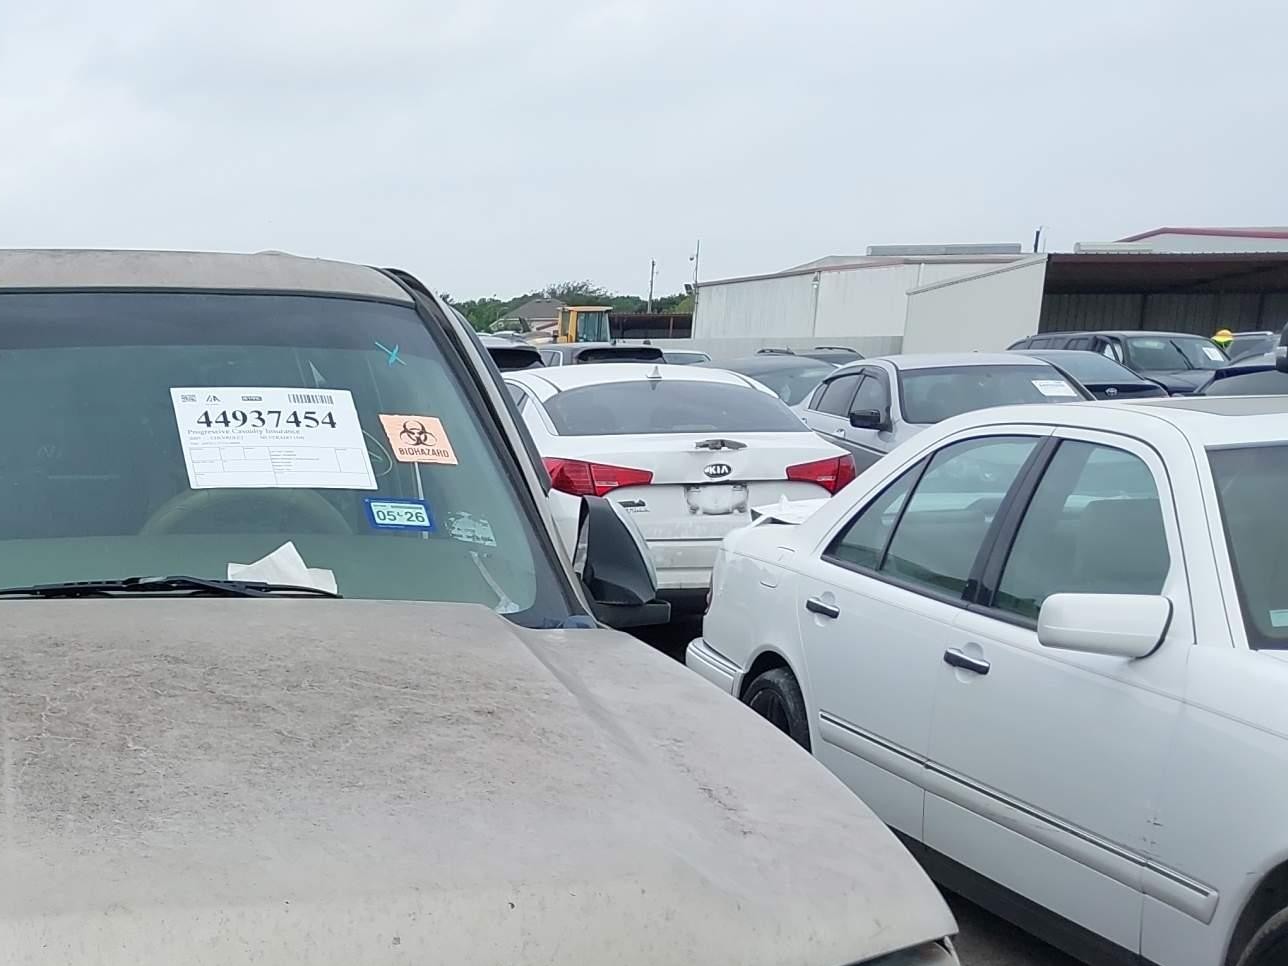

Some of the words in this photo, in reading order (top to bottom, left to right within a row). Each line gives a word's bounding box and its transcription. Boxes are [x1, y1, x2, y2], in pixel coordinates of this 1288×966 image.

[196, 410, 337, 429] 44937454
[265, 428, 301, 436] Insurance
[398, 447, 450, 458] BIOHAZARD
[709, 465, 729, 474] KIA
[376, 510, 397, 522] 05
[404, 511, 426, 523] 26
